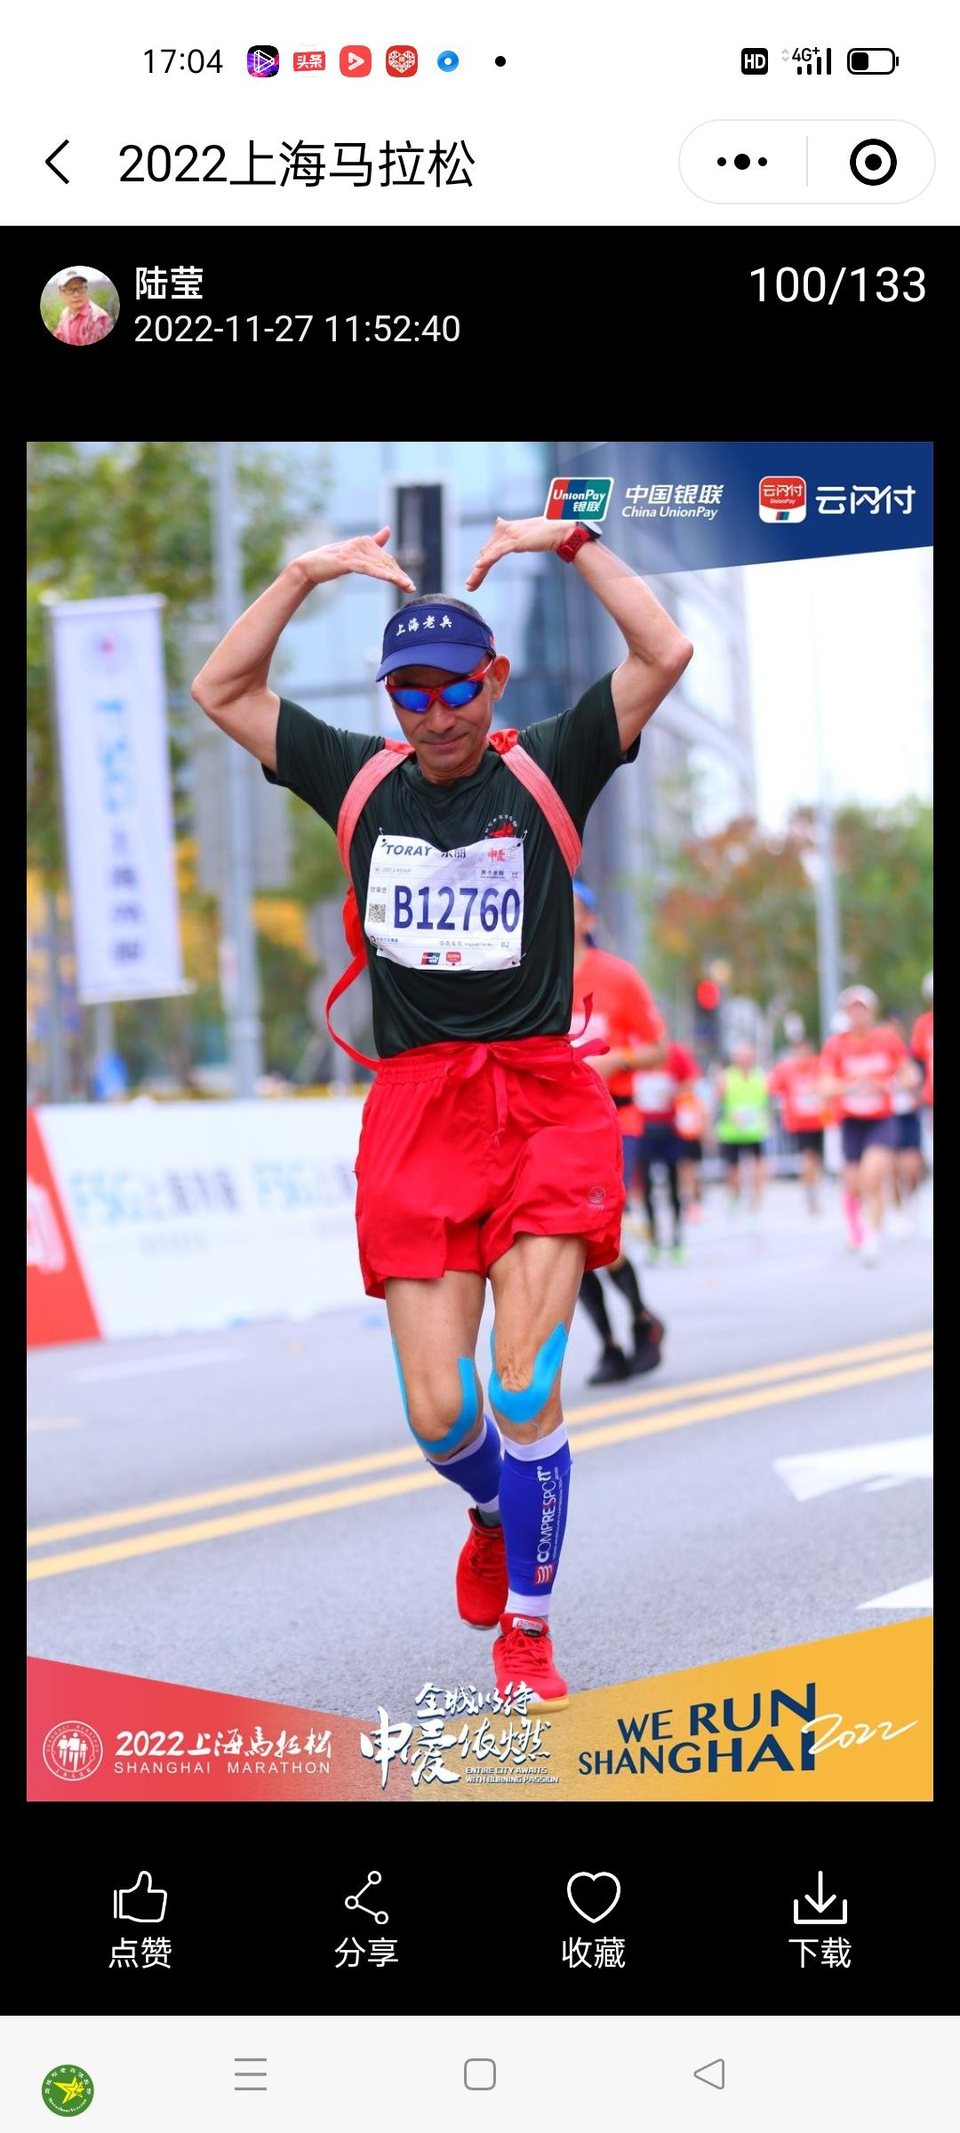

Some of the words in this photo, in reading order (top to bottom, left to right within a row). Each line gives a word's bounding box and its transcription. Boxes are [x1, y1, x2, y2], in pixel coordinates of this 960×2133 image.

[145, 49, 223, 74] 17:04
[296, 55, 323, 69] 头条
[745, 53, 766, 69] HD
[120, 139, 476, 188] 2022上海马拉松
[135, 265, 204, 301] 陆莹
[750, 266, 926, 306] 100/133
[134, 315, 314, 342] 2022-11-27
[325, 315, 460, 342] 11:52:40
[396, 615, 452, 636] 上海老兵
[386, 844, 432, 857] TORAY
[394, 885, 520, 932] B12760
[108, 1936, 172, 1969] 点赞
[334, 1936, 399, 1969] 分享
[562, 1936, 626, 1969] 收藏
[788, 1936, 852, 1969] 下载
